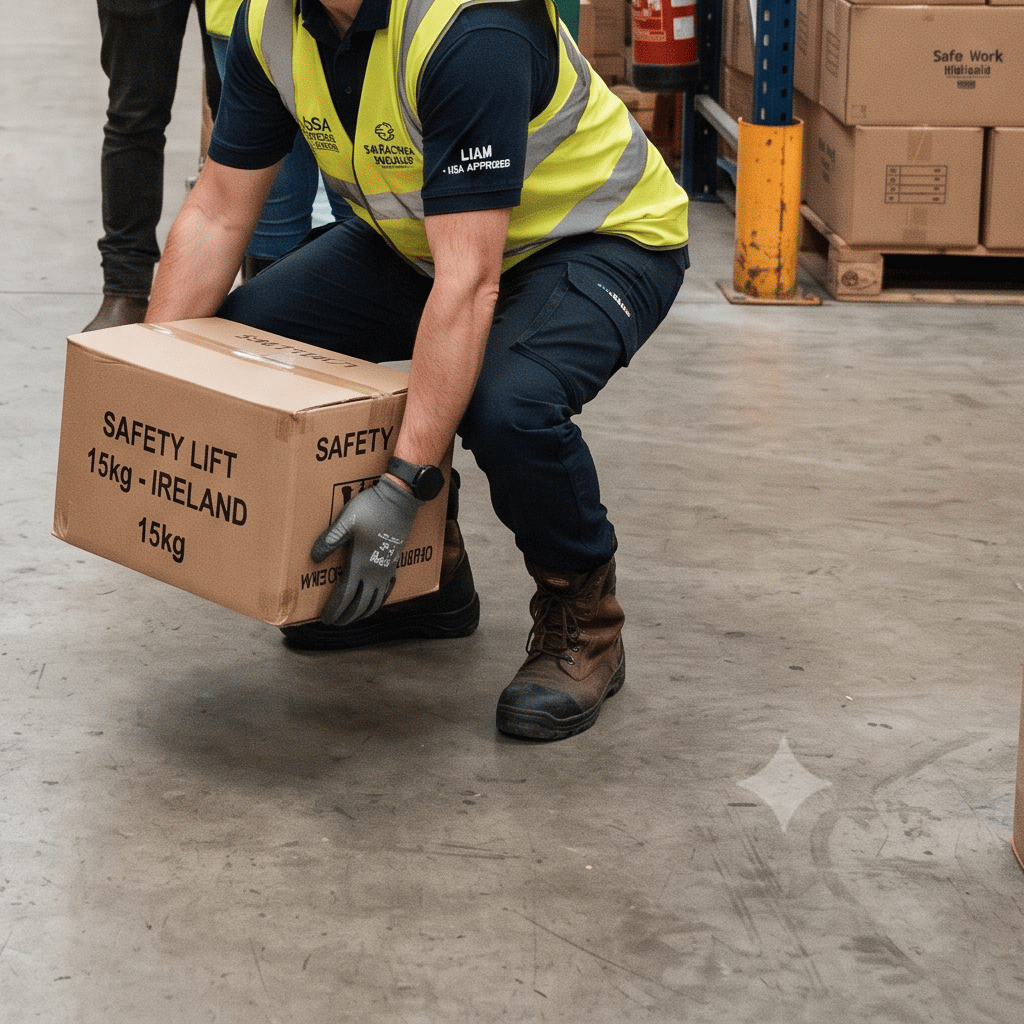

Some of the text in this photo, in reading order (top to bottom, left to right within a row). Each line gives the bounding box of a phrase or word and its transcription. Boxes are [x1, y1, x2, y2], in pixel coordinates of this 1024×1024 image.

[933, 48, 1004, 64] Safe Work
[460, 145, 493, 162] LIAM
[102, 410, 238, 479] SAFETY LIFT
[315, 426, 395, 462] SAFETY
[87, 447, 133, 493] 15kg
[151, 469, 248, 527] IRELAND
[138, 516, 186, 564] 15kg
